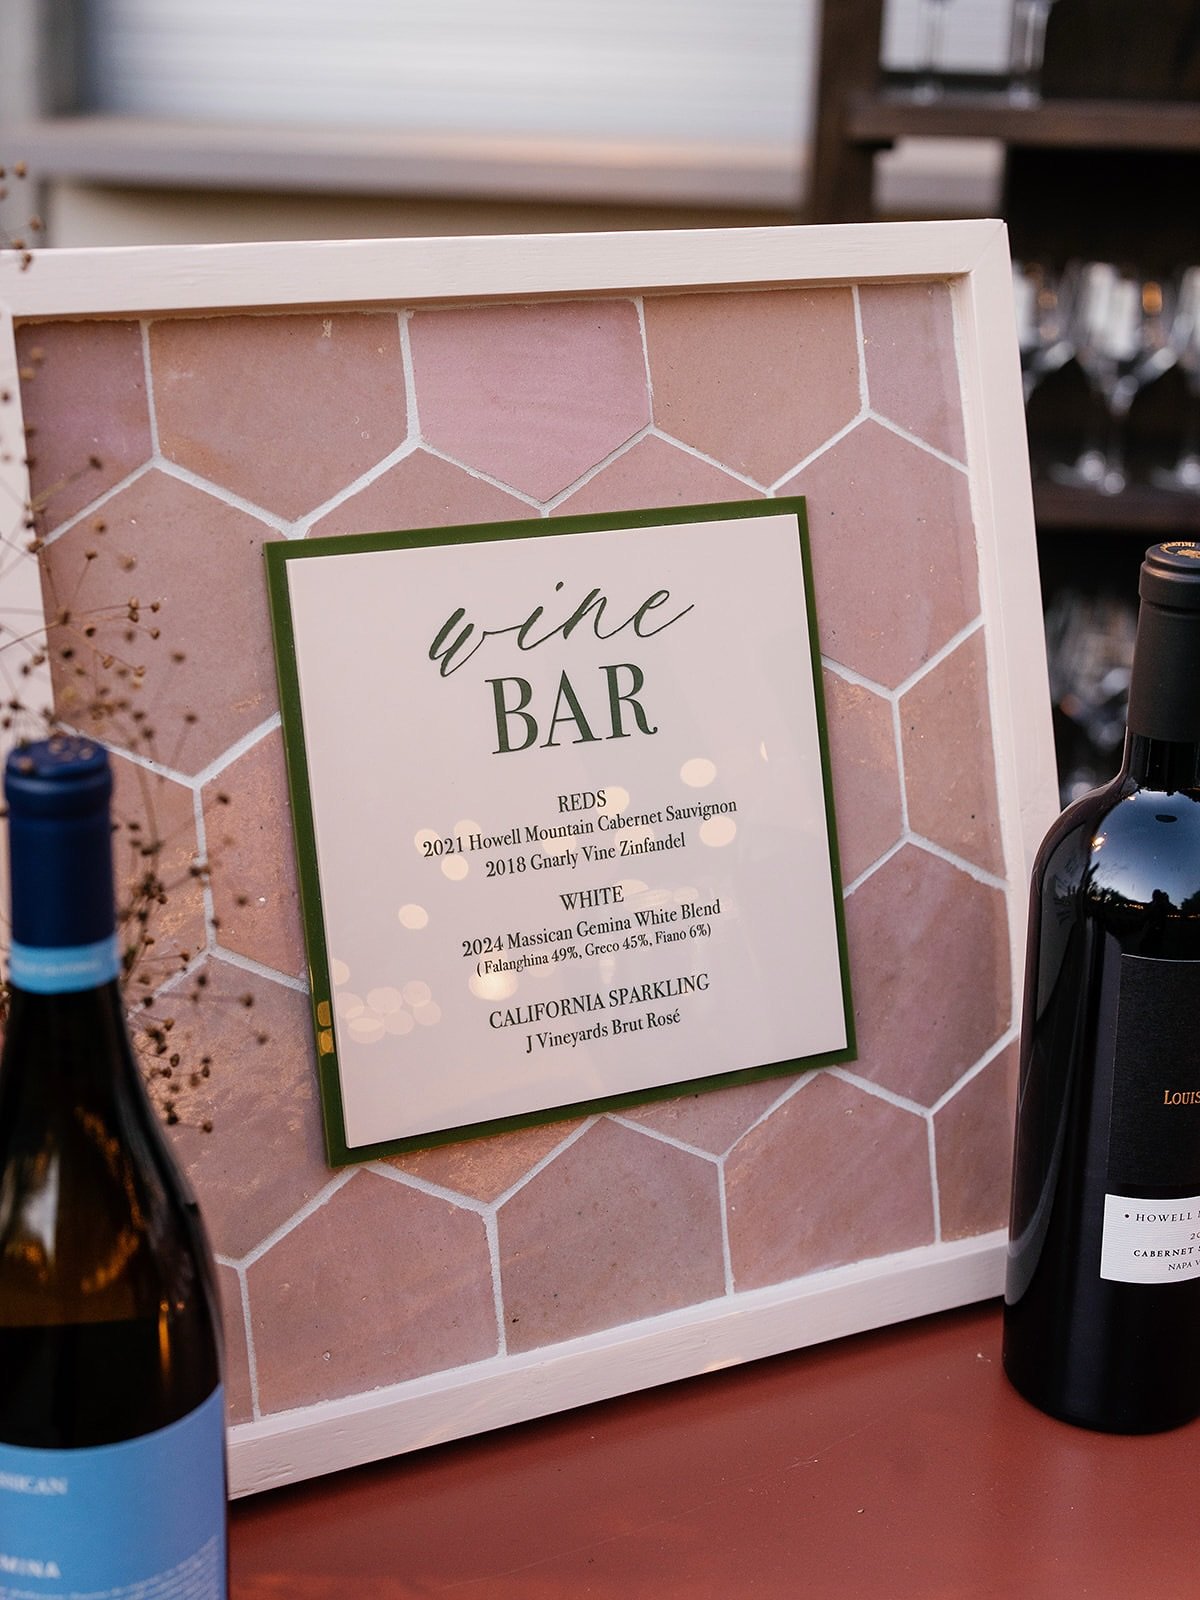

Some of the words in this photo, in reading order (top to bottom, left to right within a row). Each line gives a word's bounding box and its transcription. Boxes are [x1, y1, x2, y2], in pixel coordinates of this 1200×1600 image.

[429, 581, 695, 677] wine
[484, 663, 658, 754] BAR
[557, 789, 608, 813] REDS
[423, 835, 464, 857] 2021
[468, 827, 521, 851] Howell
[525, 818, 594, 842] Mountain
[597, 810, 663, 832] Cabernet
[665, 799, 737, 822] Sauvignon
[485, 856, 527, 878] 2018
[530, 846, 579, 870] Gnarly
[582, 843, 617, 862] Vine
[619, 831, 686, 857] Zinfandel
[559, 885, 625, 911] WHITE
[461, 935, 504, 958] 2024
[507, 927, 573, 950] Massican
[576, 917, 631, 938] Gemina
[634, 908, 678, 928] White
[681, 899, 722, 920] Blend
[551, 946, 583, 962] 49%,
[584, 940, 620, 957] Greco
[622, 933, 653, 952] 45%,
[655, 928, 687, 945] Fiano
[689, 922, 712, 939] 6%)
[489, 992, 606, 1029] CALIFORNIA
[608, 973, 711, 1008] SPARKLING
[526, 1035, 534, 1054] J
[536, 1022, 609, 1048] Vineyards
[612, 1017, 645, 1036] Brut
[646, 1008, 681, 1029] Rosé
[1163, 1089, 1200, 1105] LOUIS
[1136, 1212, 1193, 1222] HOWELL
[1133, 1246, 1194, 1258] CABERNET
[1168, 1261, 1192, 1271] NAPA
